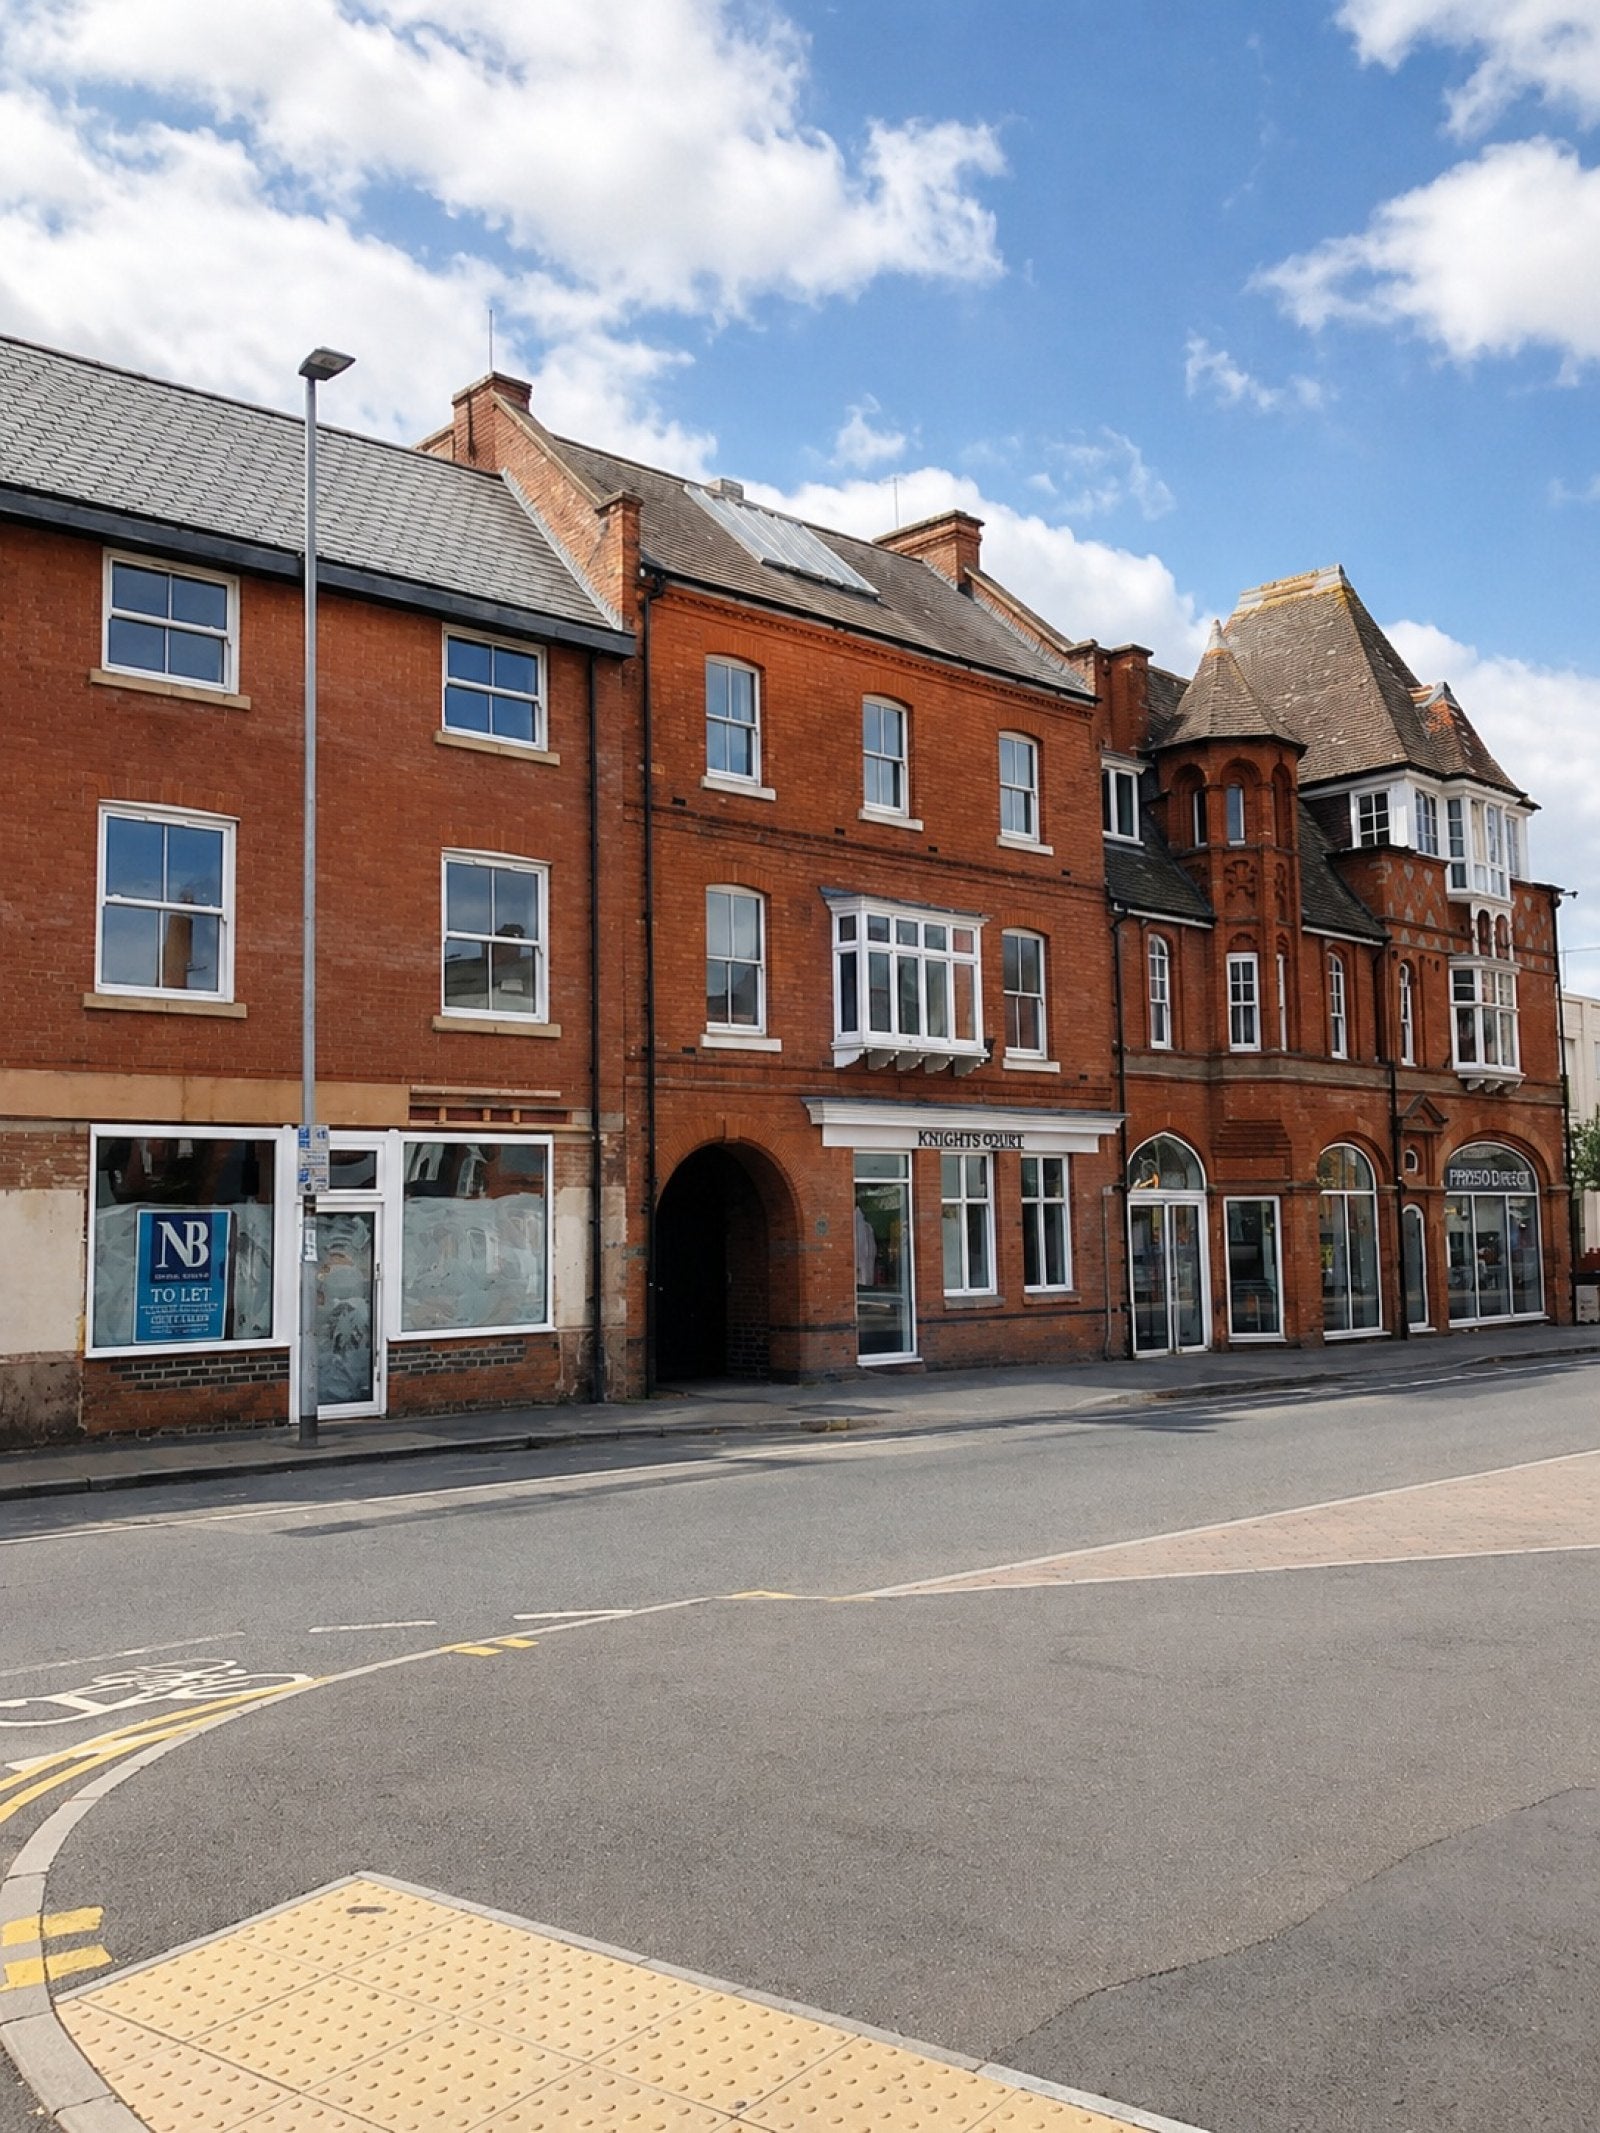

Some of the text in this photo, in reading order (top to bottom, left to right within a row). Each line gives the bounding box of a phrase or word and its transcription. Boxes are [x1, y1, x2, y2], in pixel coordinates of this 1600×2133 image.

[918, 1131, 980, 1148] KNIGHTS
[155, 1221, 209, 1268] NB
[150, 1287, 212, 1303] TO LET
